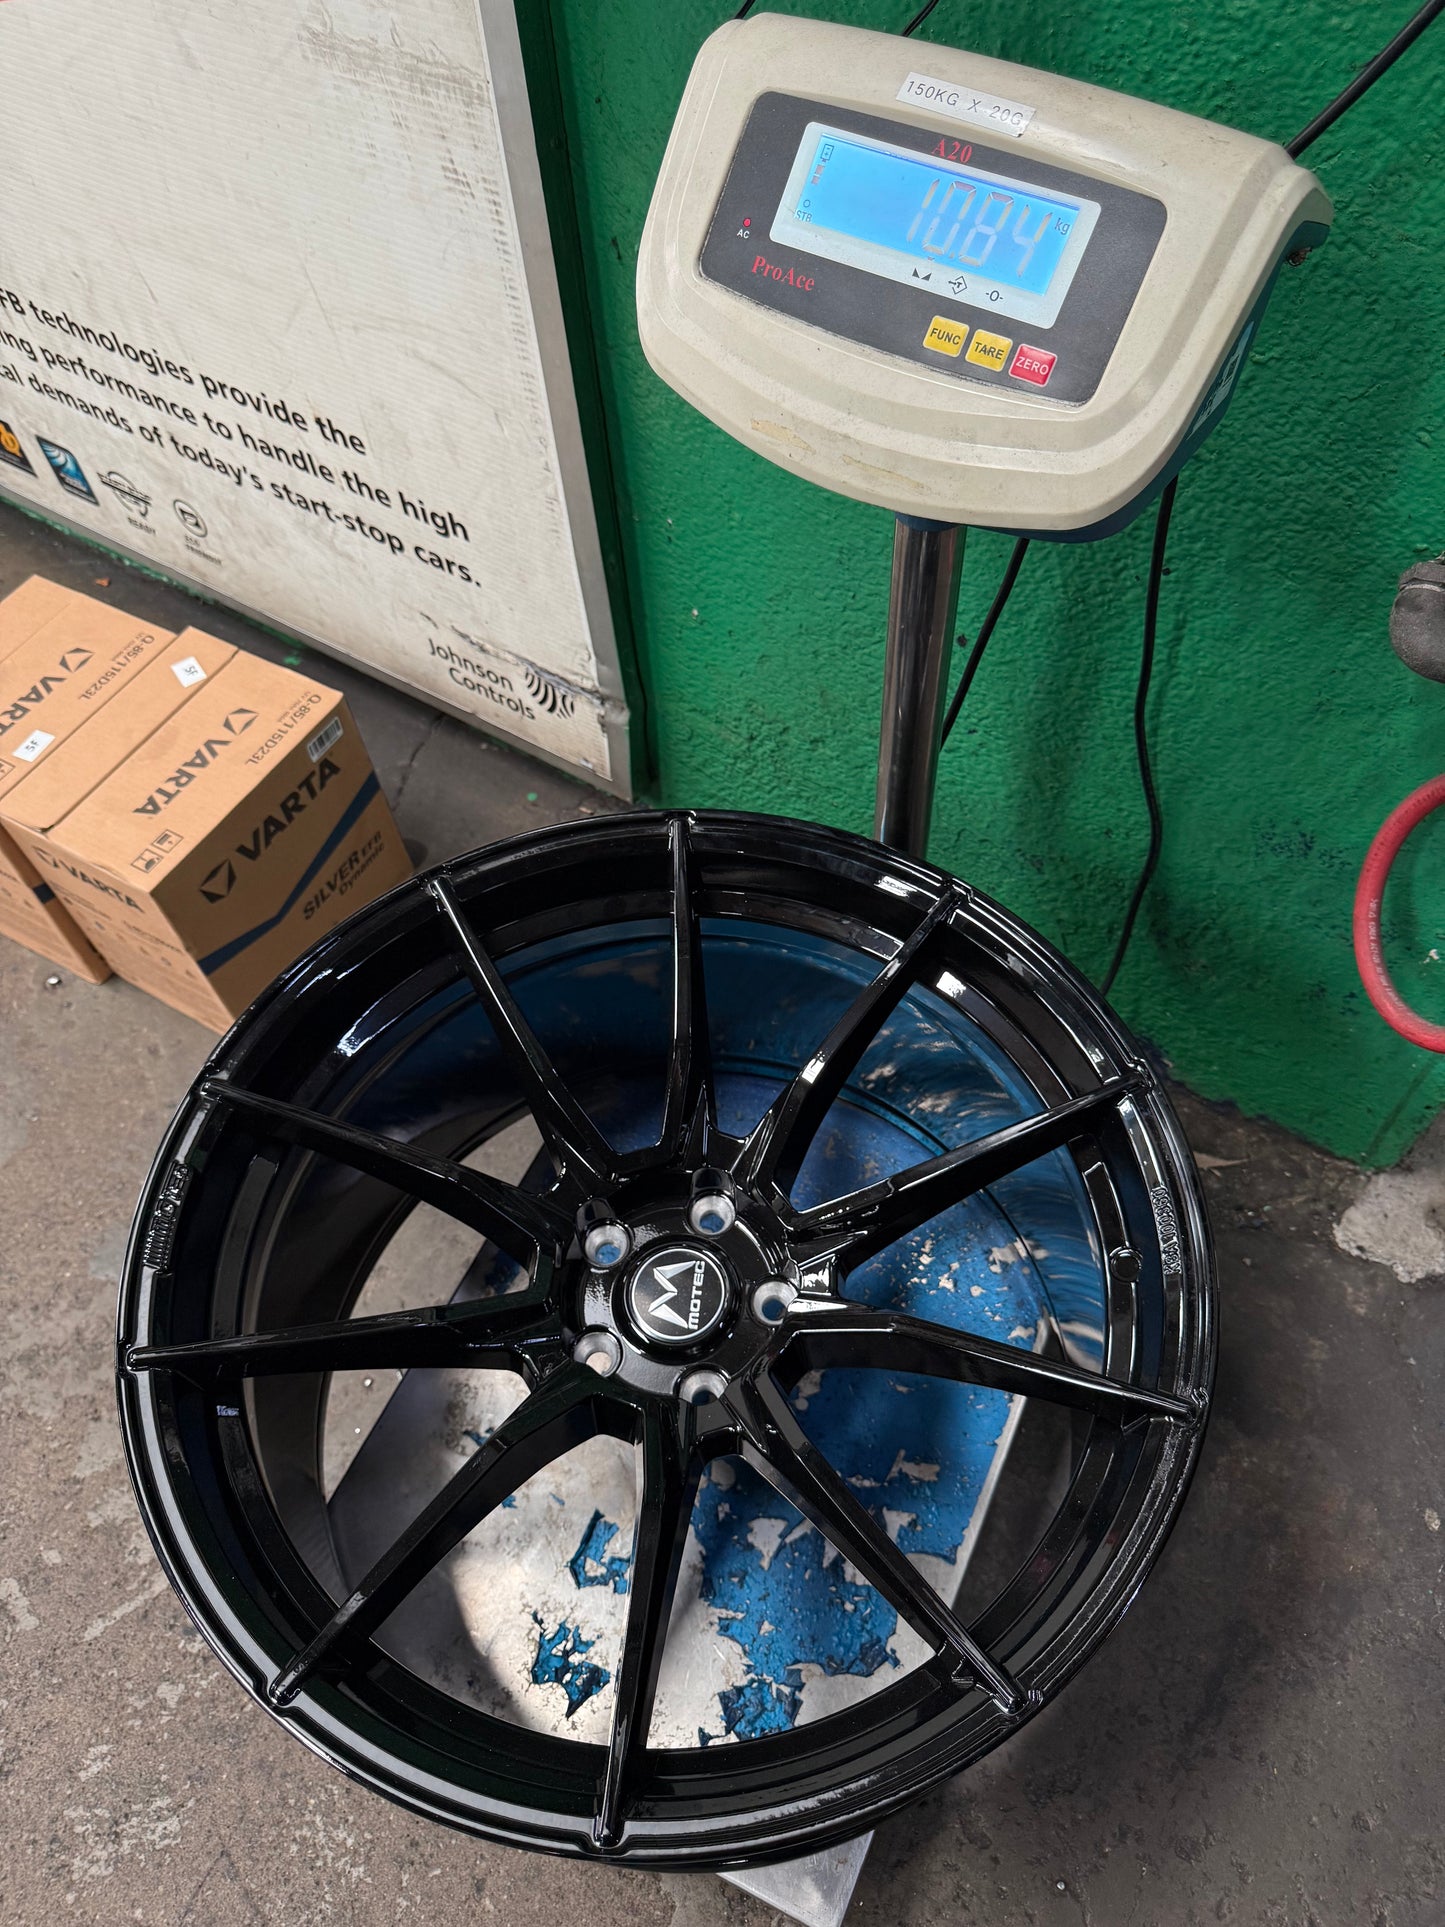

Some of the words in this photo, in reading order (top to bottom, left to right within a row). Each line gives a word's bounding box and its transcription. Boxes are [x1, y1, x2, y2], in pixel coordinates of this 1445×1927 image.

[906, 80, 960, 106] 150KG
[967, 98, 982, 113] X
[989, 105, 1024, 126] 20G
[931, 138, 973, 164] A20
[736, 228, 750, 239] AC
[1054, 217, 1070, 236] kg
[751, 255, 815, 292] ProAce
[929, 327, 961, 345] FUNC
[974, 341, 1004, 360] TARE
[29, 300, 194, 385] technologies
[200, 373, 308, 432] provide
[315, 416, 366, 456] the
[1015, 356, 1049, 376] ZERO
[39, 345, 198, 426] performance
[203, 412, 233, 440] to
[237, 423, 335, 484] handle
[341, 470, 392, 508] the
[398, 490, 470, 542] high
[28, 372, 133, 435] demands
[139, 425, 165, 448] of
[170, 434, 265, 492] today's
[270, 482, 406, 556] start-stop
[414, 545, 482, 588] cars.
[428, 637, 515, 692] Johnson
[449, 667, 537, 722] Controls
[132, 738, 233, 816] VARTA
[235, 757, 341, 862] VARTA
[303, 851, 362, 921] SILVER
[687, 1260, 706, 1331] MOTEC
